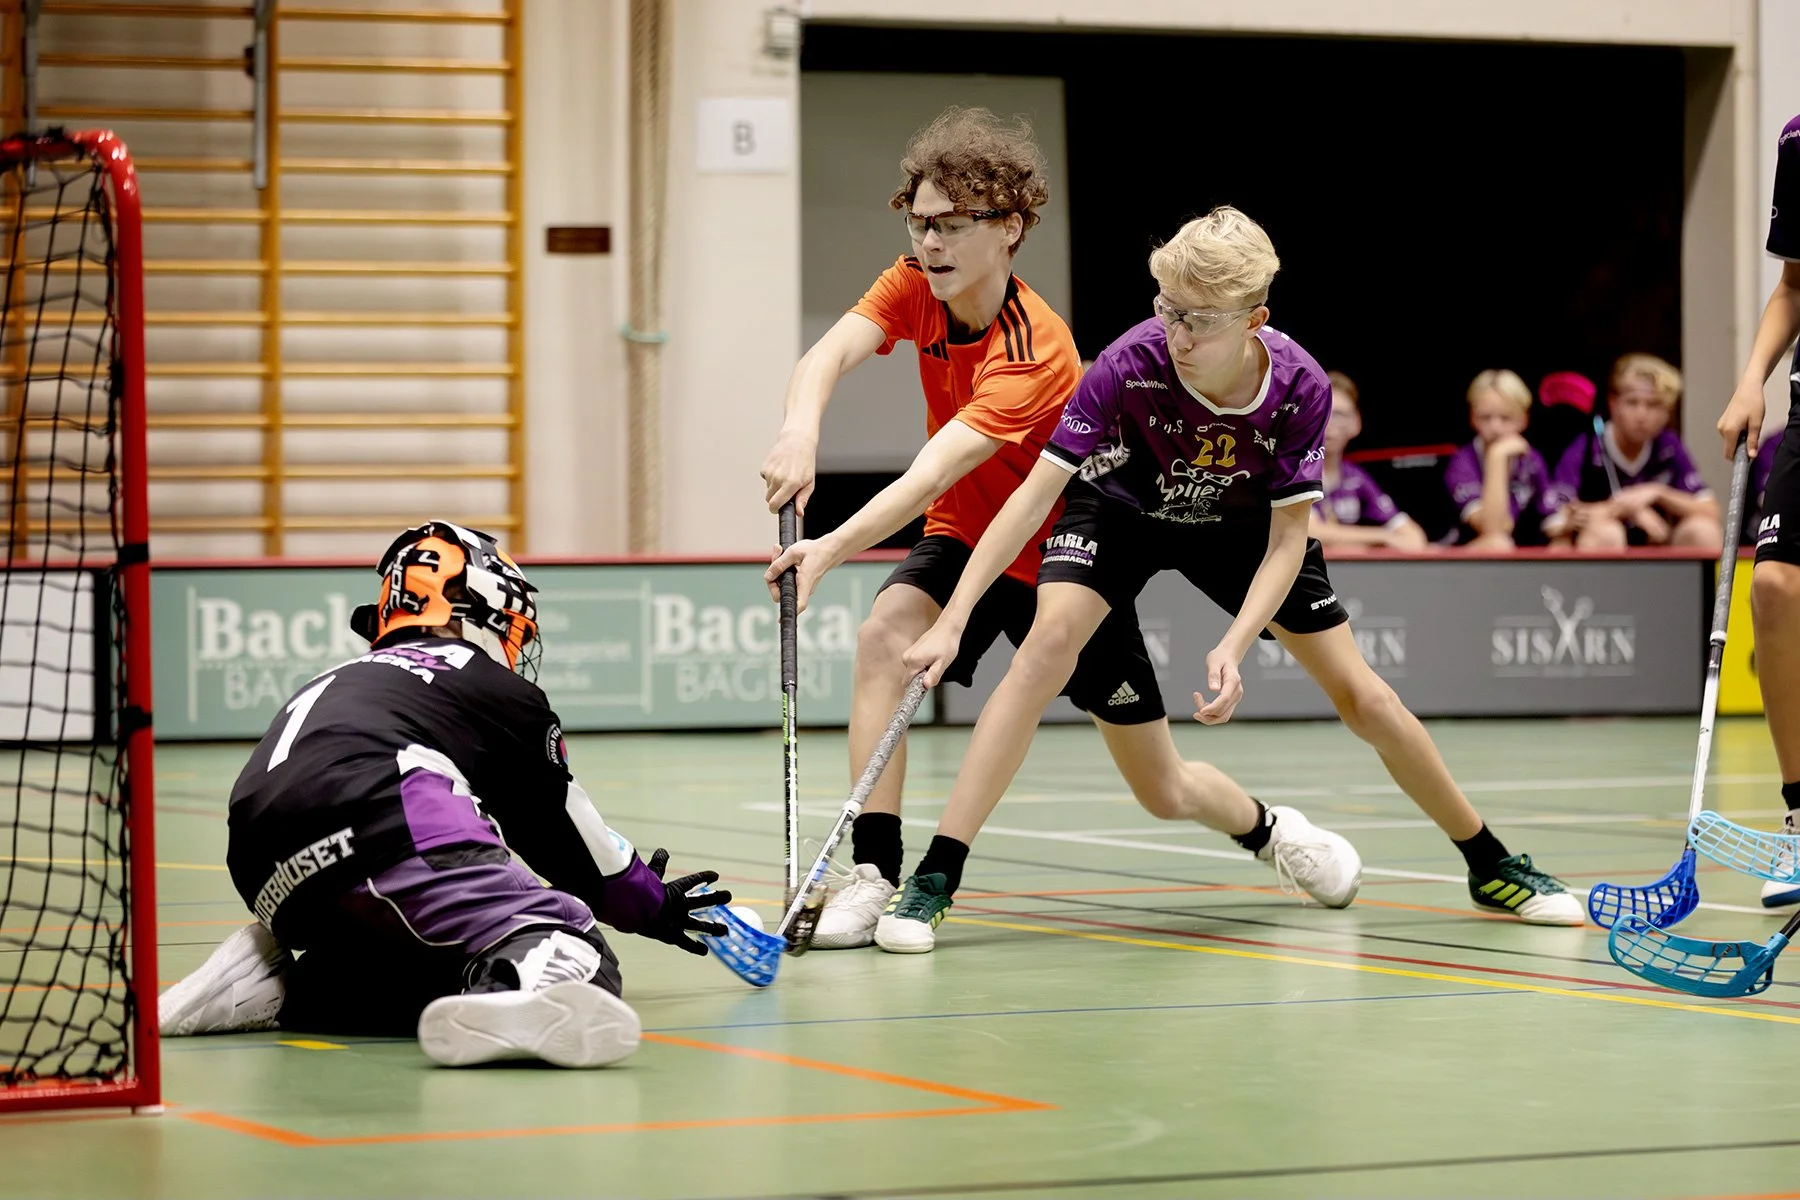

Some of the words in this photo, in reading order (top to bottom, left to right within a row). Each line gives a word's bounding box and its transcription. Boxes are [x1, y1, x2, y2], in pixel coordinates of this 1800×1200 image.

[731, 119, 757, 156] B
[1191, 433, 1236, 467] 22
[1046, 533, 1098, 556] VARLA
[1108, 693, 1140, 706] adidas
[266, 673, 336, 774] 1
